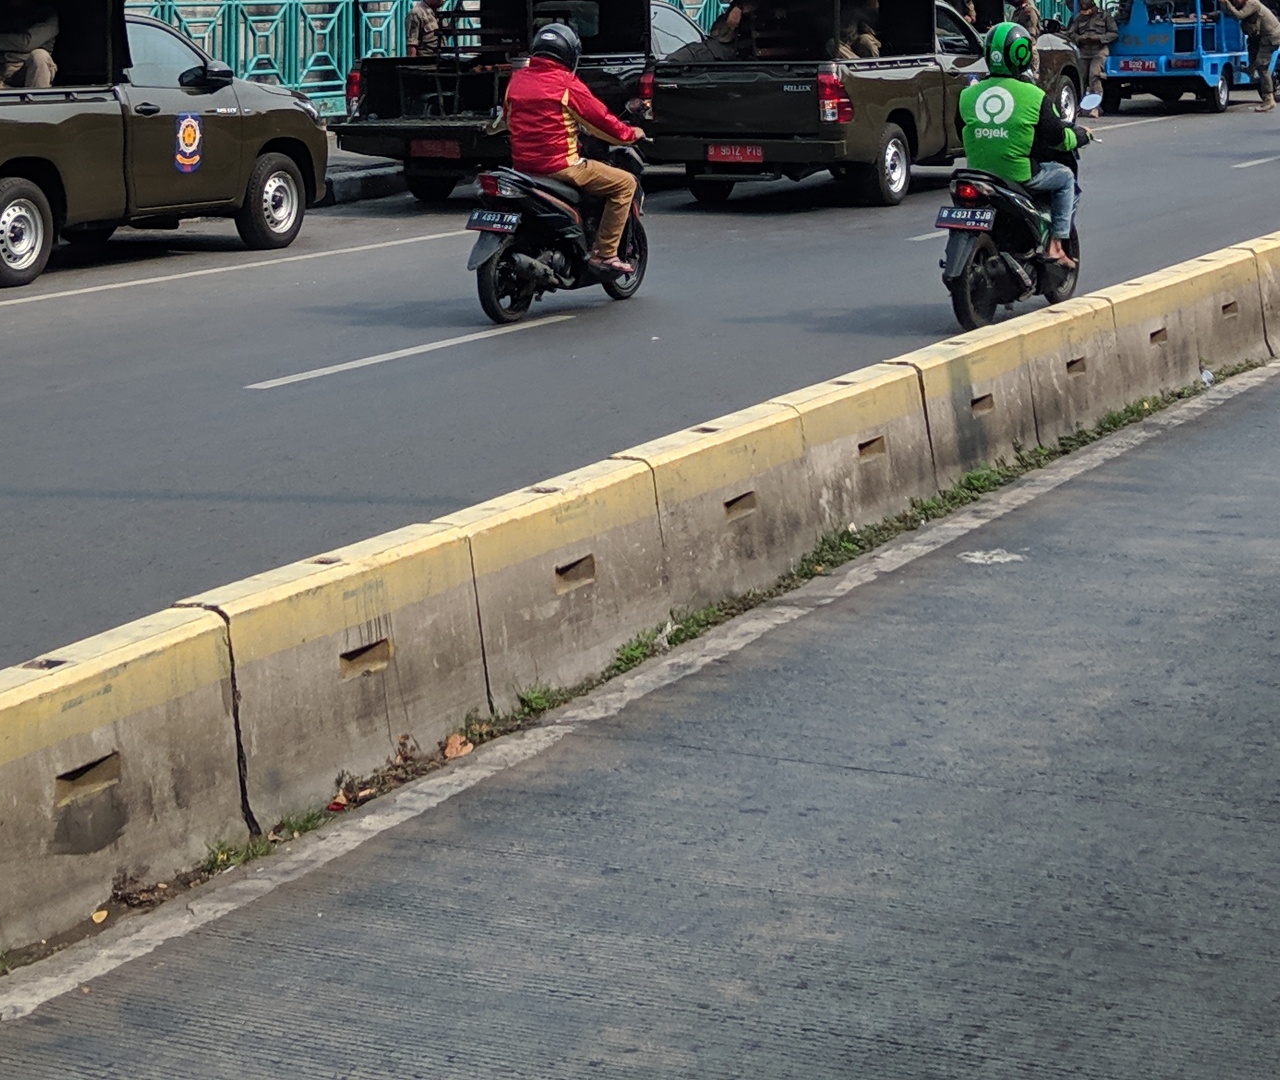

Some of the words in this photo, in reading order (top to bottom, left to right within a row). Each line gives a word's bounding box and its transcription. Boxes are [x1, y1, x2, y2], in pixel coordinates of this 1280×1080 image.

[974, 127, 1009, 139] gojek
[709, 145, 714, 155] B
[941, 209, 948, 218] B
[951, 210, 971, 219] 4931
[975, 211, 992, 220] SJB
